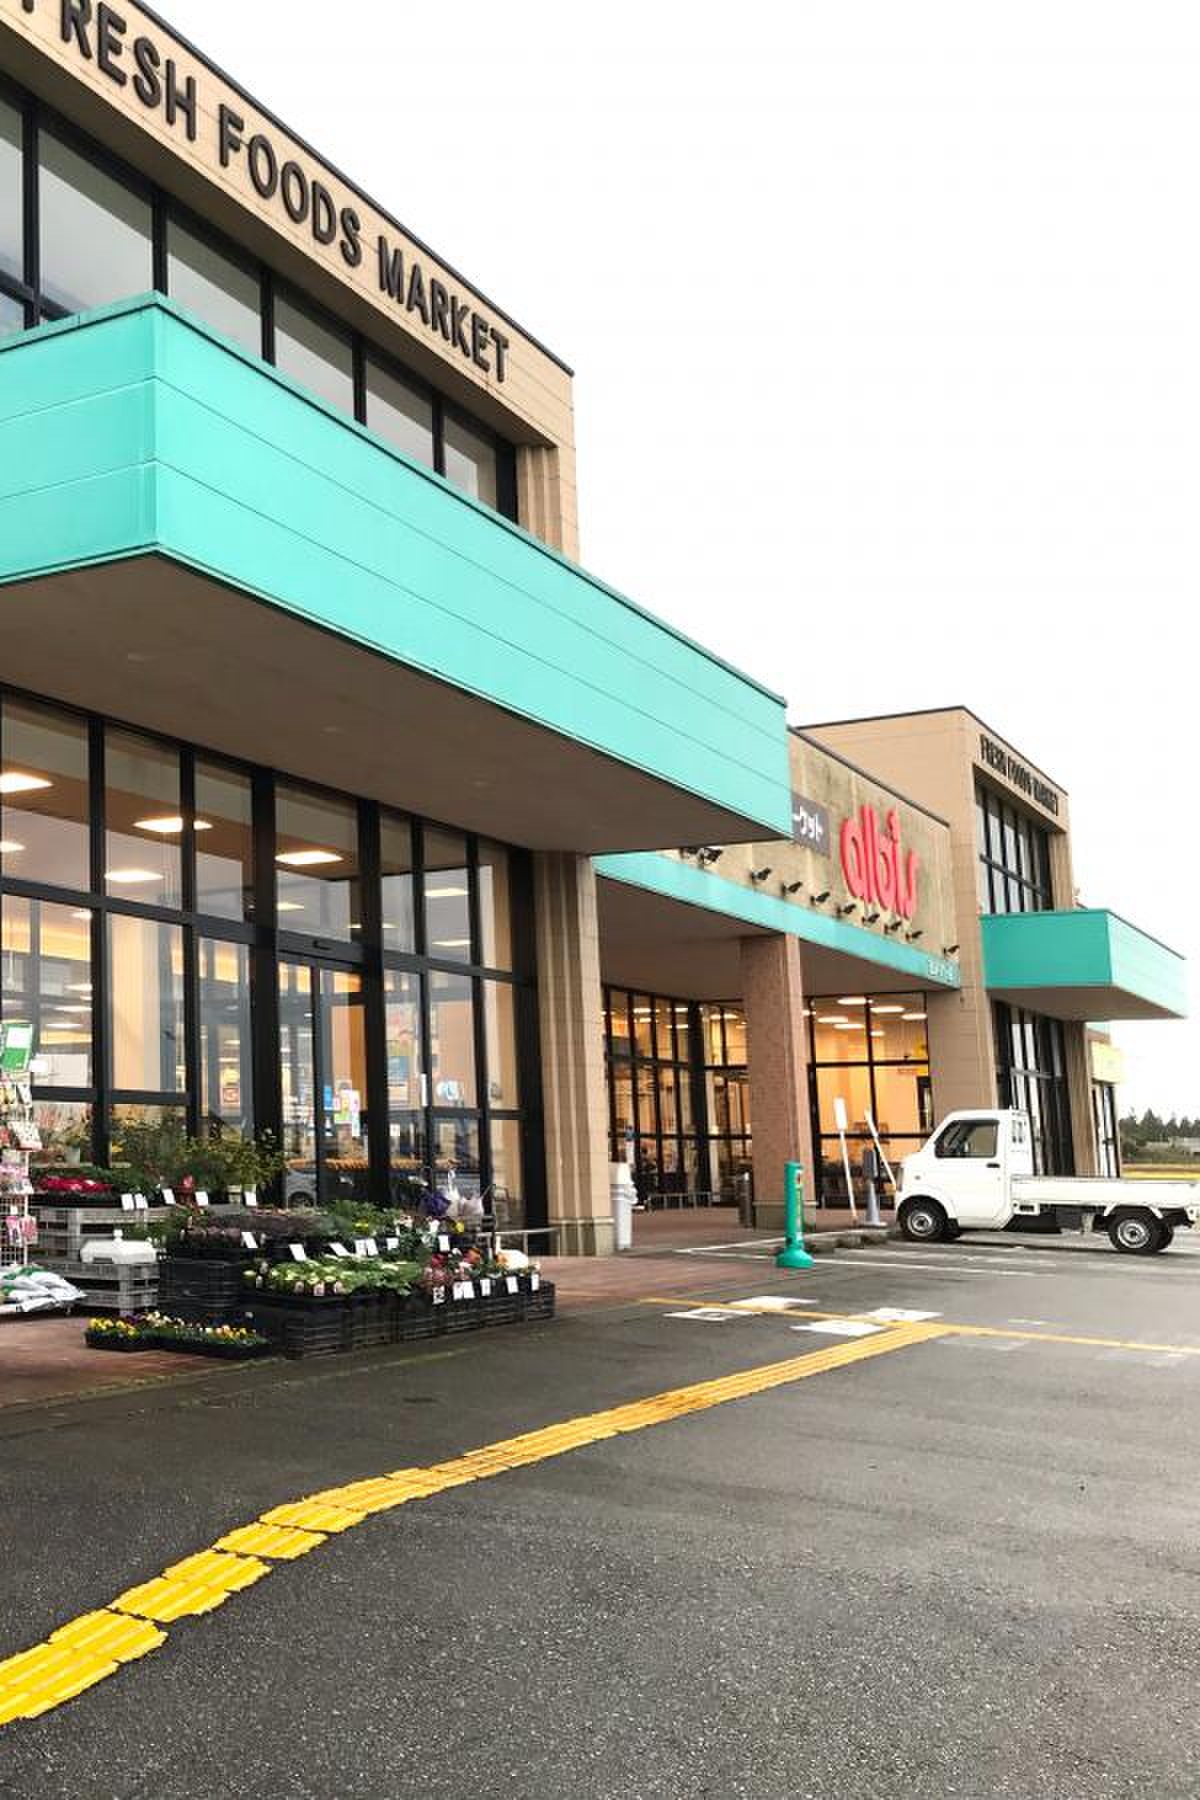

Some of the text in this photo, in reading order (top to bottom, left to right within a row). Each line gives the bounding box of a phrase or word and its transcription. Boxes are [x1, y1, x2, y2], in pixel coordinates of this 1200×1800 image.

[22, 0, 509, 382] RESH FOODS MARKET
